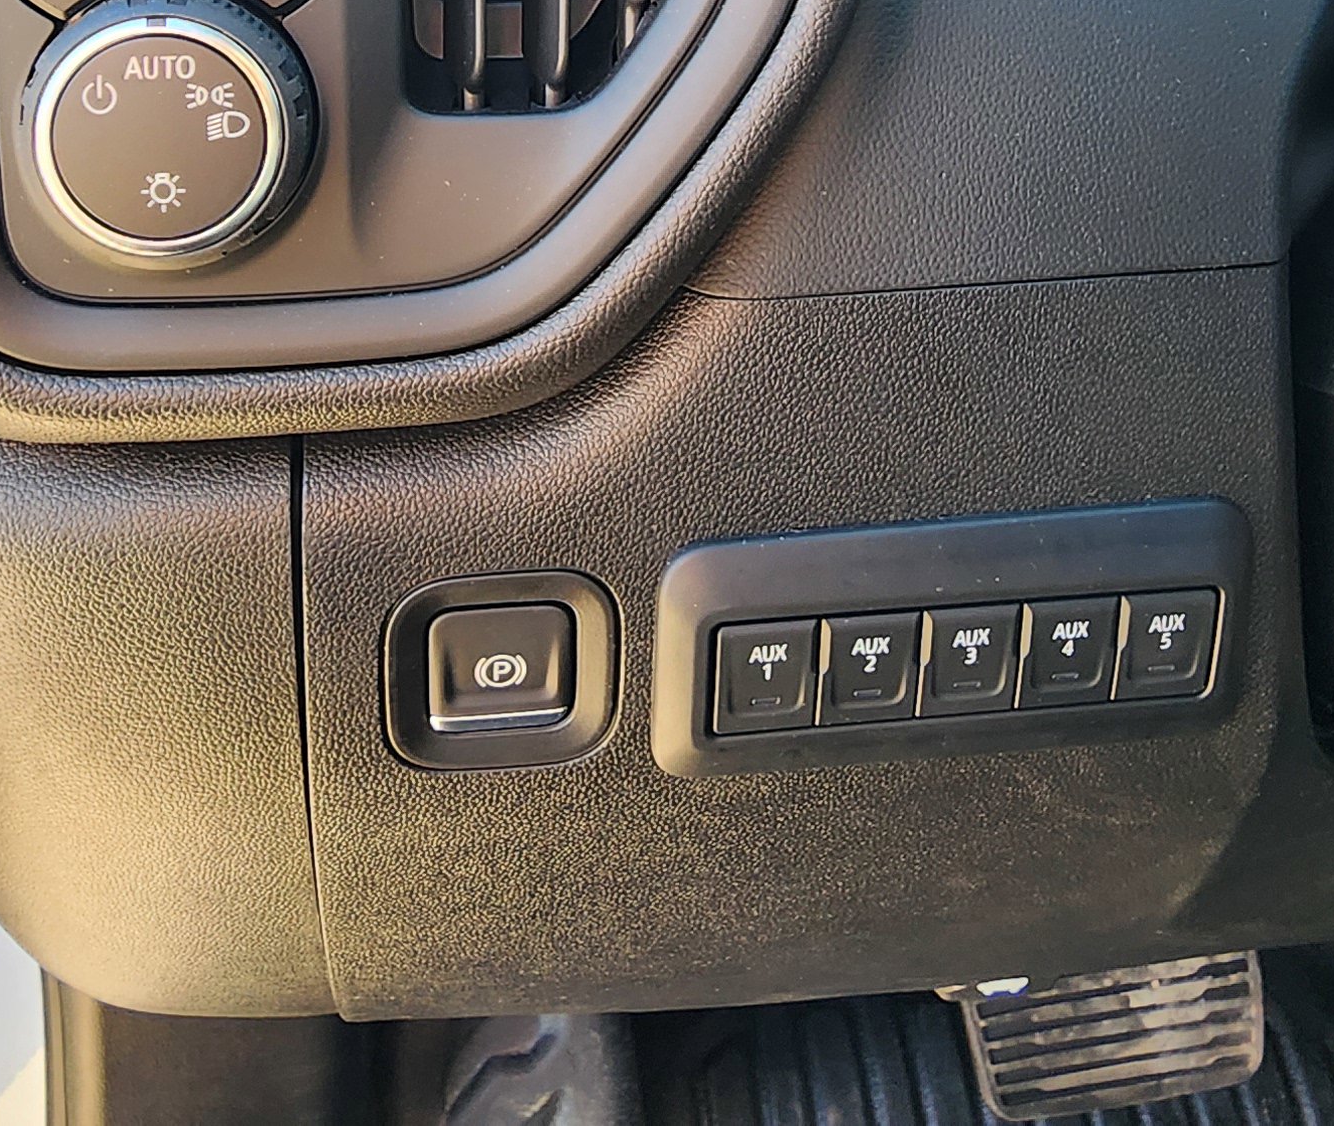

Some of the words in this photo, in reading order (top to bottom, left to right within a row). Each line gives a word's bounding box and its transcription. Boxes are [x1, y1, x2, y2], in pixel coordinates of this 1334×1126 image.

[123, 55, 196, 80] AUTO
[1052, 620, 1090, 640] AUX
[1148, 613, 1186, 633] AUX
[851, 636, 891, 656] AUX
[952, 628, 991, 648] AUX
[1061, 639, 1075, 657] 4
[1159, 632, 1172, 650] 5
[748, 643, 788, 664] AUX
[964, 647, 978, 665] 3
[762, 663, 772, 681] 1
[863, 655, 877, 673] 2
